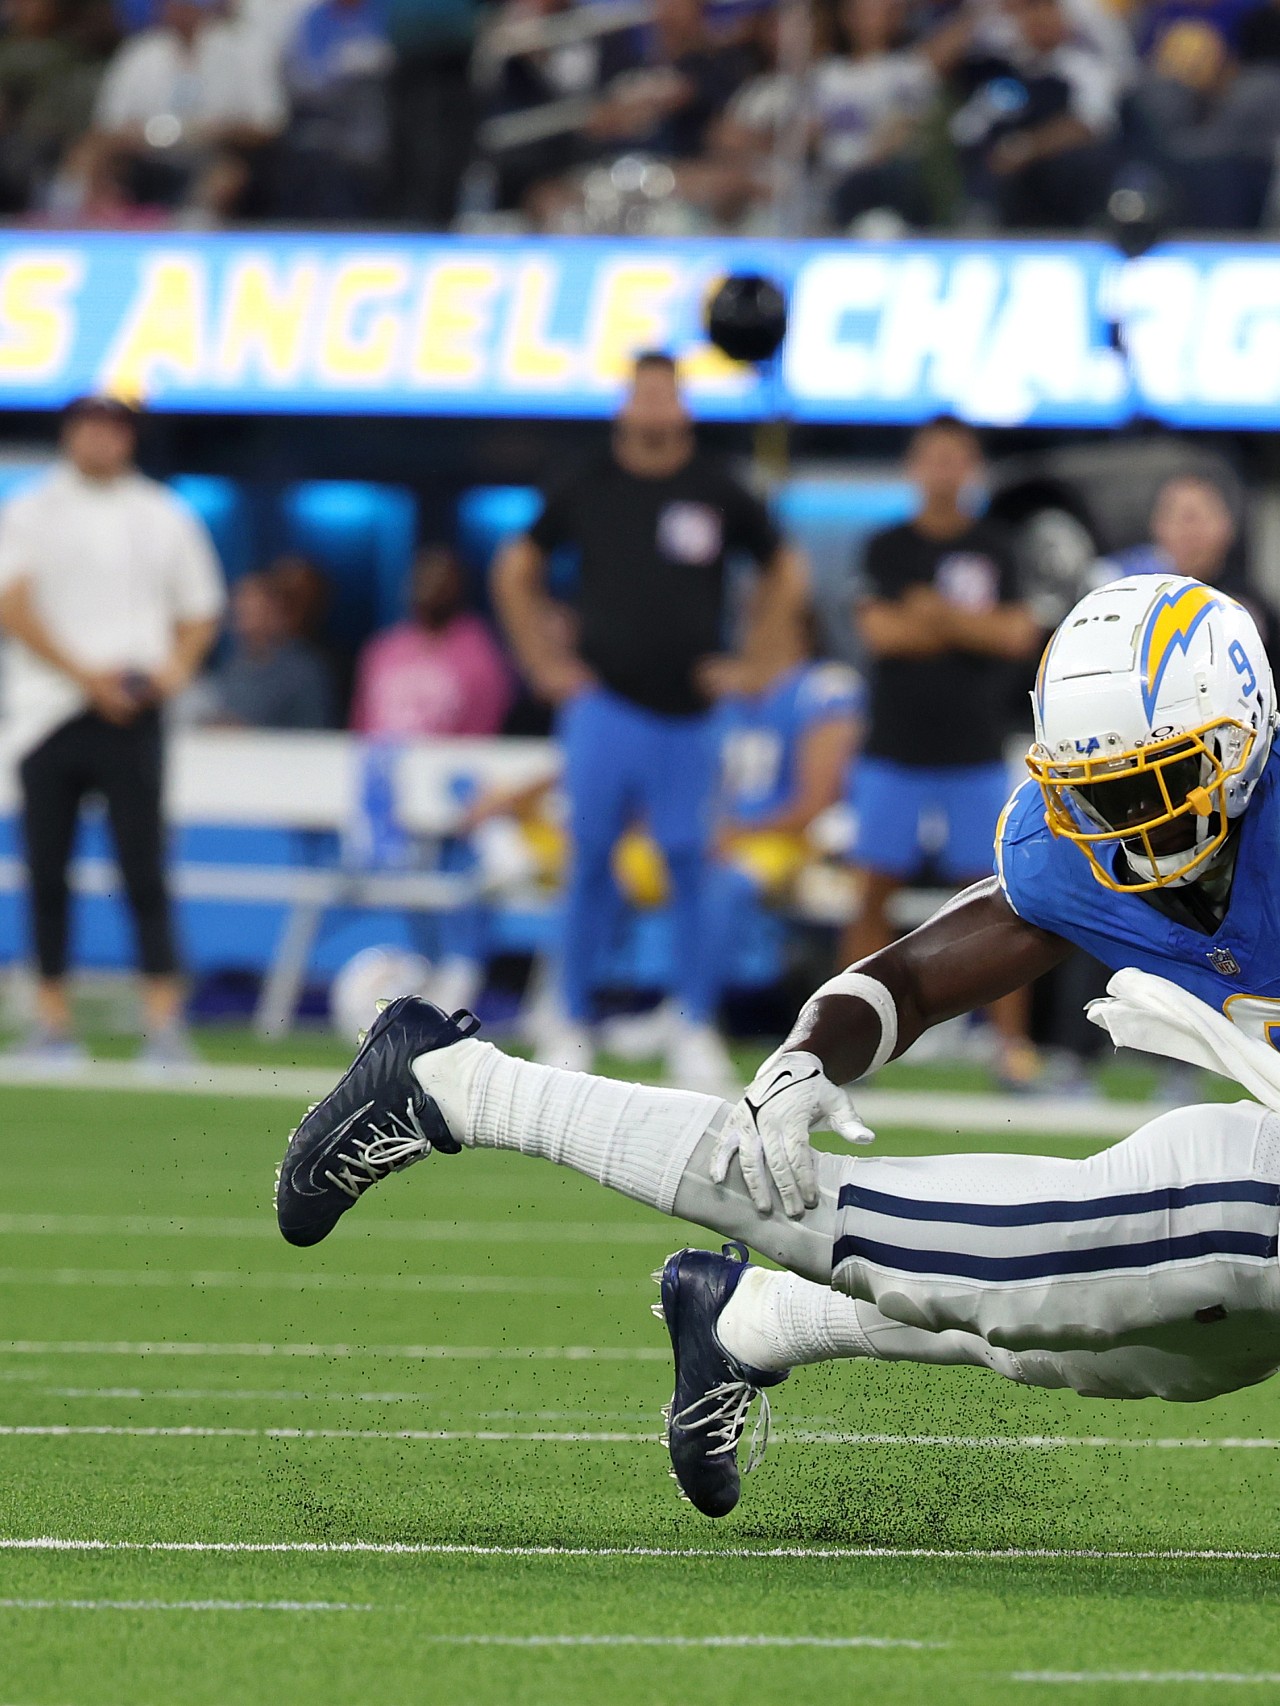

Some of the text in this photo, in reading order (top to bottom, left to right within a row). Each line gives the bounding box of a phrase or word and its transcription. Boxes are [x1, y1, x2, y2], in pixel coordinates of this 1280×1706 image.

[1228, 639, 1257, 698] 9
[1074, 737, 1100, 758] LA
[1217, 960, 1238, 973] NFL
